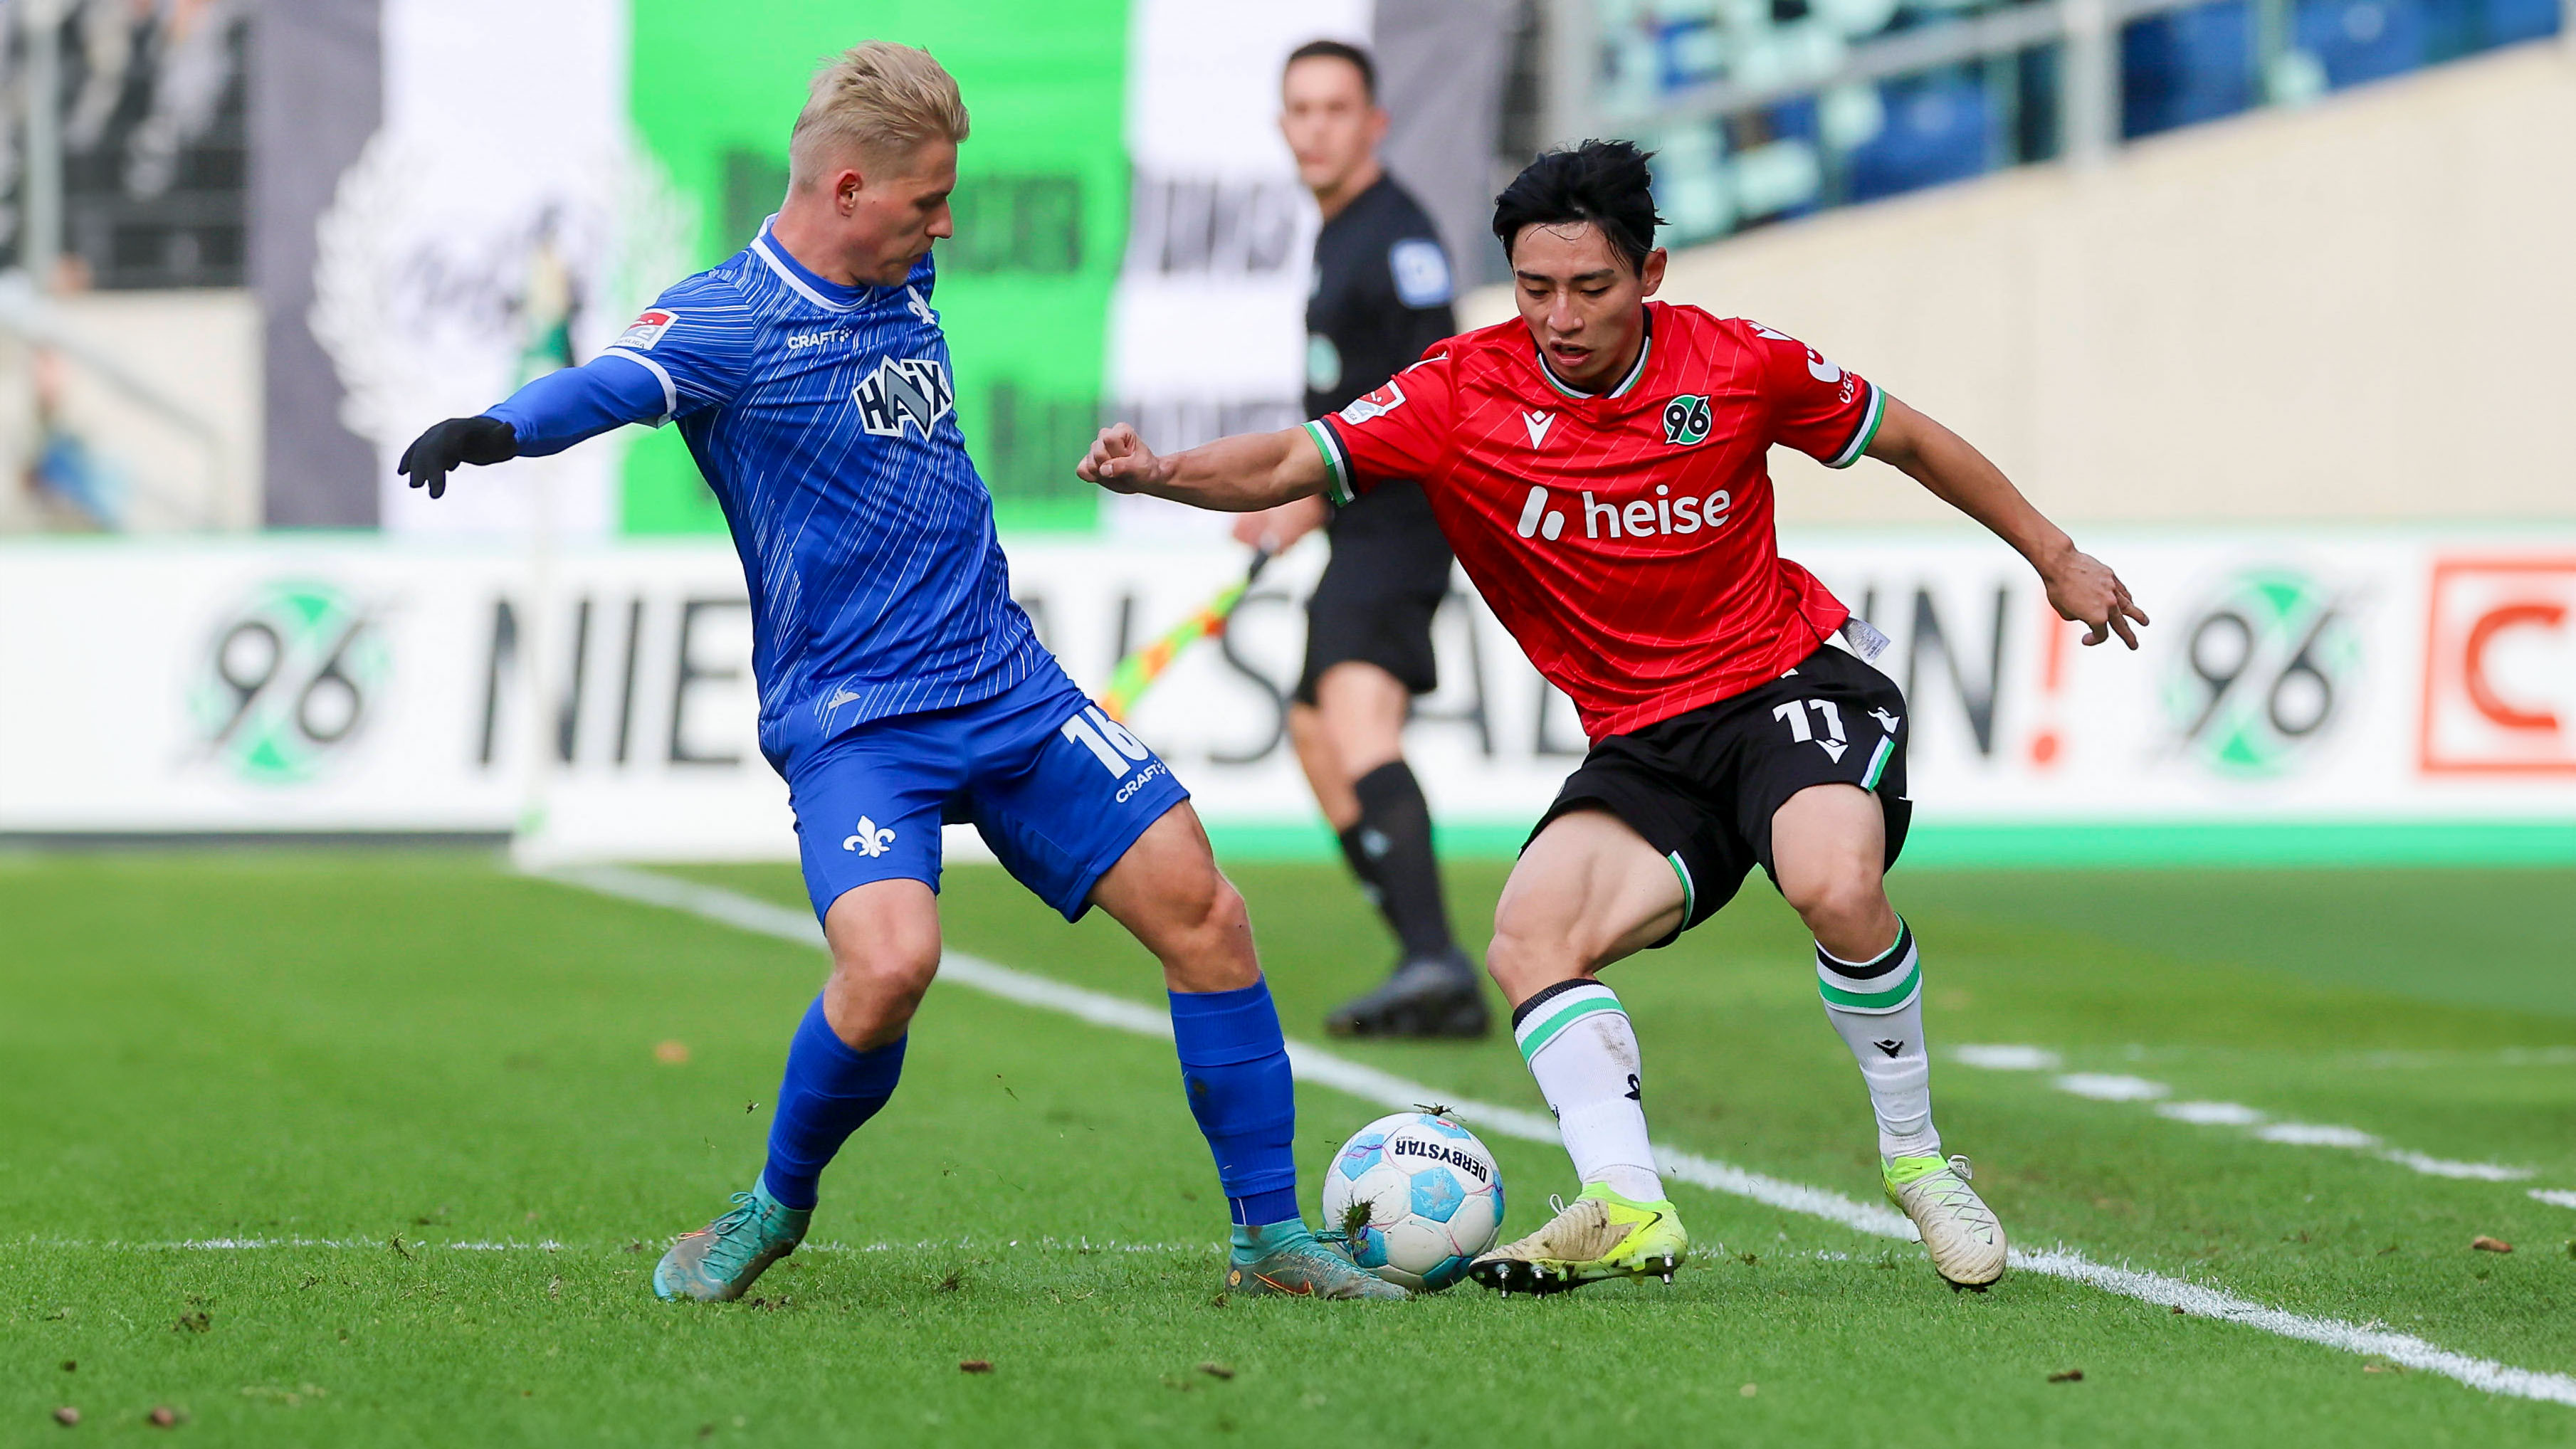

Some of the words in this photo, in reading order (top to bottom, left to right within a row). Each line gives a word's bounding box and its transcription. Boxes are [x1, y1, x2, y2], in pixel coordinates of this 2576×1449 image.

[787, 330, 839, 349] CRAFT
[1664, 395, 1712, 444] 96
[1582, 485, 1730, 539] heise
[1060, 705, 1149, 780] 16
[1772, 699, 1848, 743] 11
[1115, 764, 1159, 803] CRAFT
[1394, 1139, 1487, 1184] DERBYSTAR
